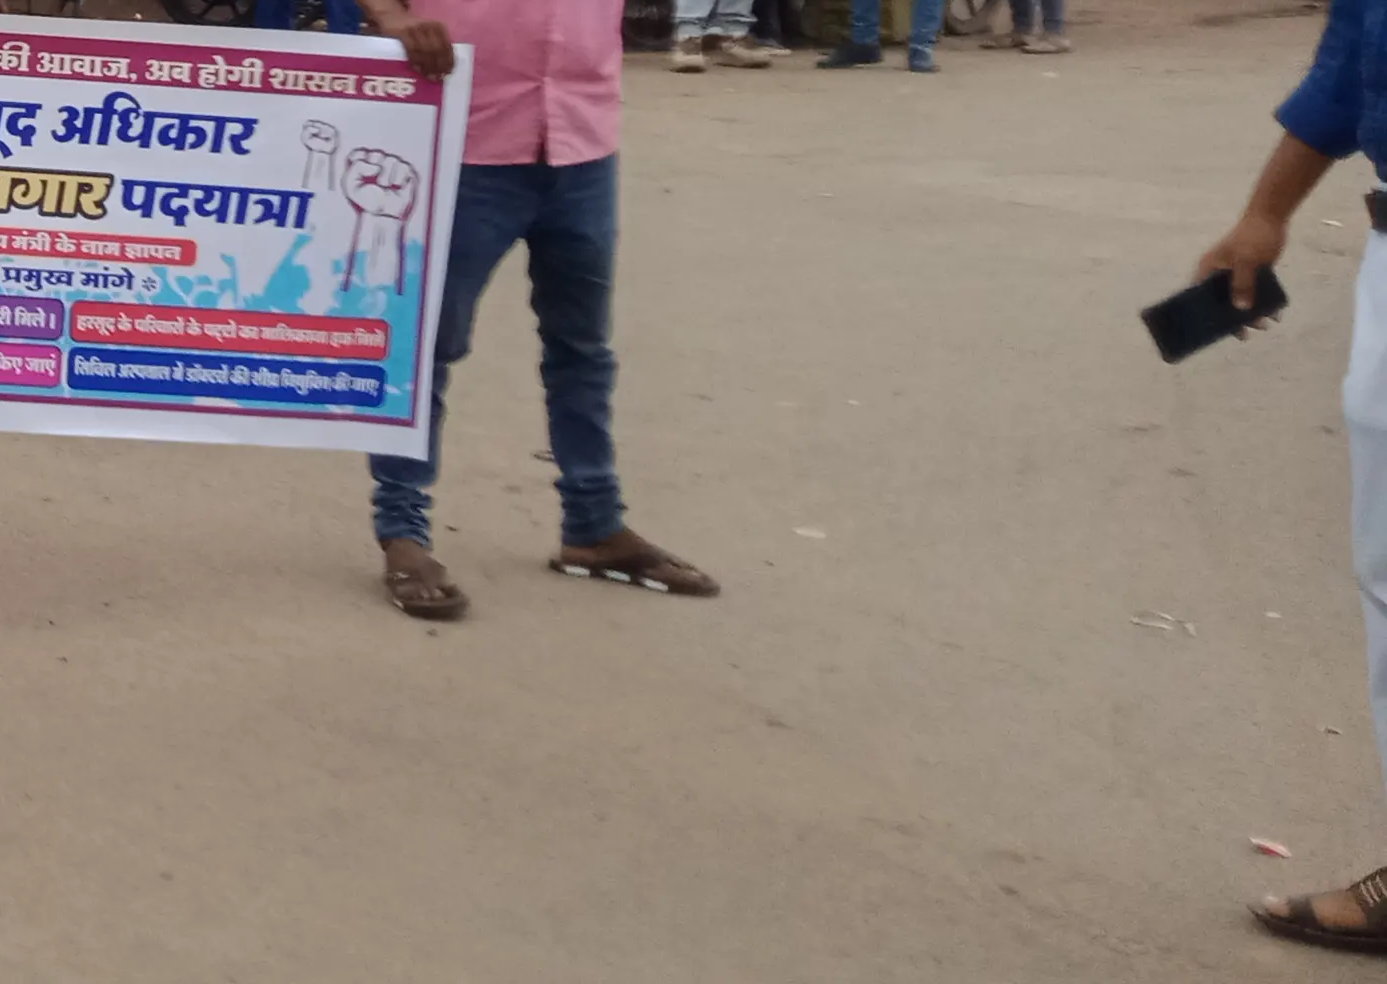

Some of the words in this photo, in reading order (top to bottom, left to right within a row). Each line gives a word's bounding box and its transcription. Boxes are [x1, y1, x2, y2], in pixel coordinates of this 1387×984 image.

[36, 51, 138, 83] आवाज,
[144, 58, 194, 83] अब
[197, 55, 265, 89] होगी
[268, 68, 358, 96] शासन
[361, 76, 417, 99] तक
[49, 90, 259, 156] अधिकार
[120, 177, 316, 230] पदयात्रा
[12, 229, 52, 253] मंत्री
[55, 233, 77, 254] के
[80, 240, 121, 257] नाम
[123, 243, 183, 260] ज्ञापन
[1, 266, 73, 290] प्रमुख
